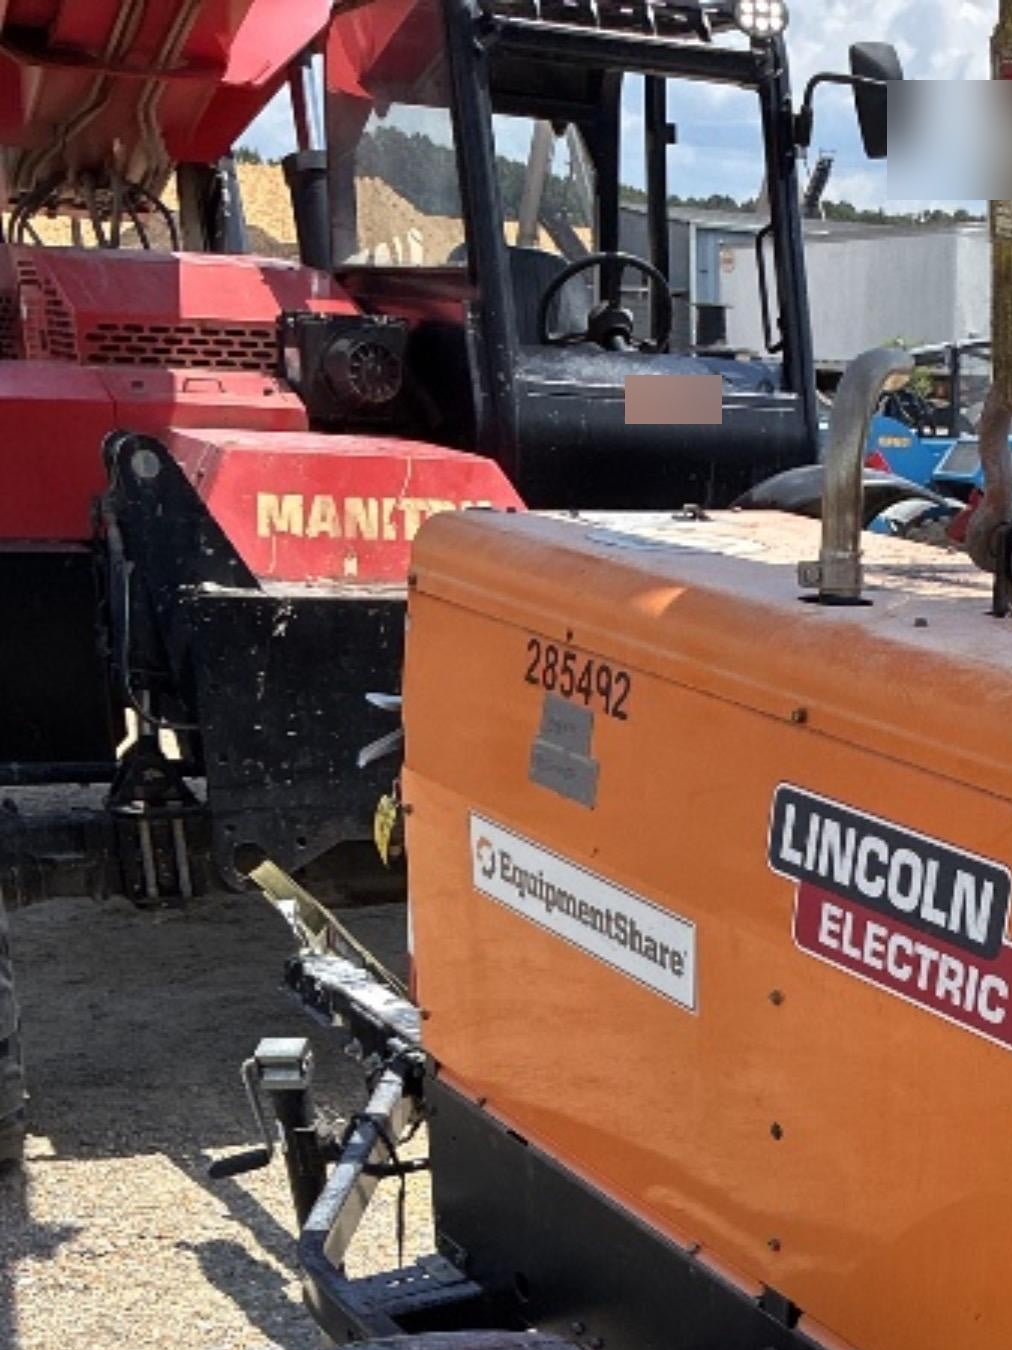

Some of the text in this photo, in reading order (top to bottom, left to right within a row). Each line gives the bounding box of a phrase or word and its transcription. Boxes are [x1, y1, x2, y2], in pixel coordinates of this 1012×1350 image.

[256, 491, 492, 541] MANIT
[525, 638, 631, 720] 285492
[500, 850, 686, 978] EquipmentShare
[779, 803, 994, 945] LINCOLN
[818, 902, 1009, 1024] ELECTRIC
